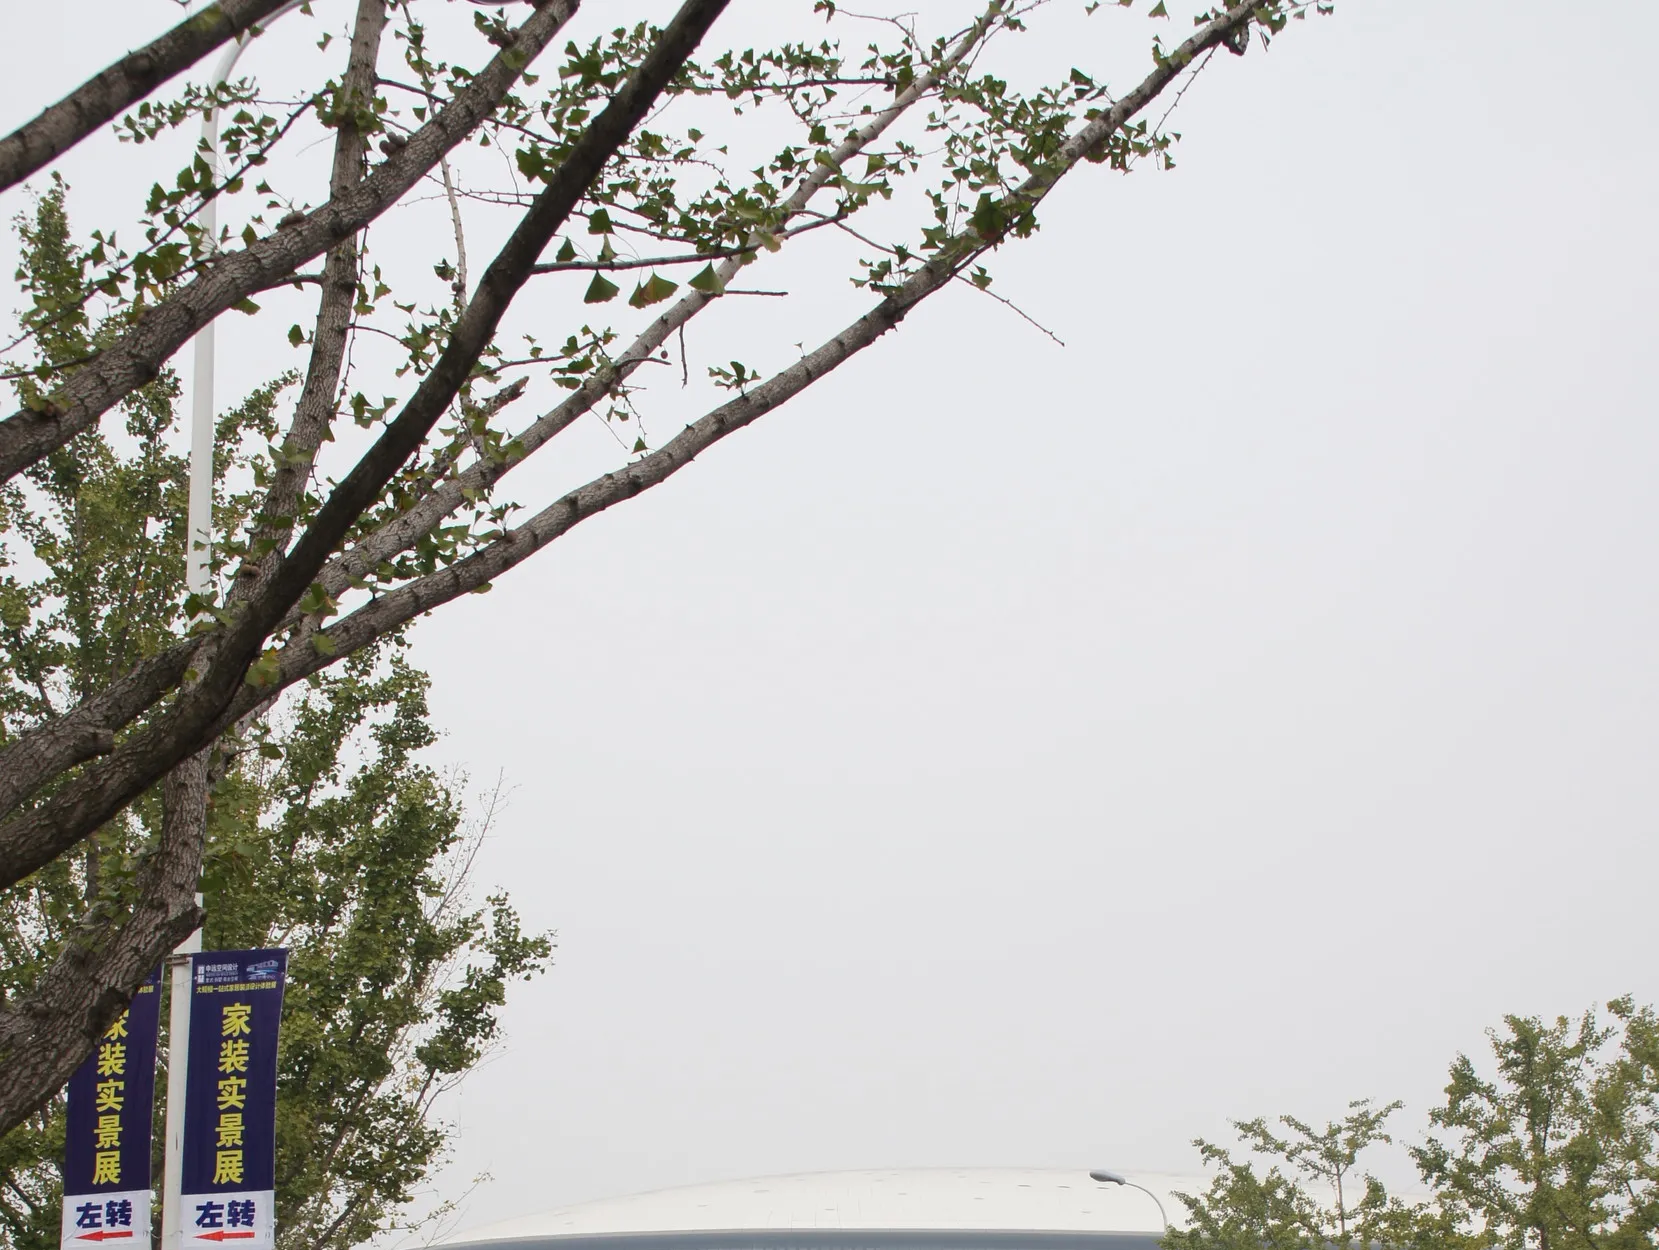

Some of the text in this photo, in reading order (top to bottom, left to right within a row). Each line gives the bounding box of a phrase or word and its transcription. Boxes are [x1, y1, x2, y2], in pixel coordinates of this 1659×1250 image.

[212, 1002, 252, 1185] 家装实景展
[76, 1199, 133, 1229] 左转
[195, 1199, 256, 1228] 左转
